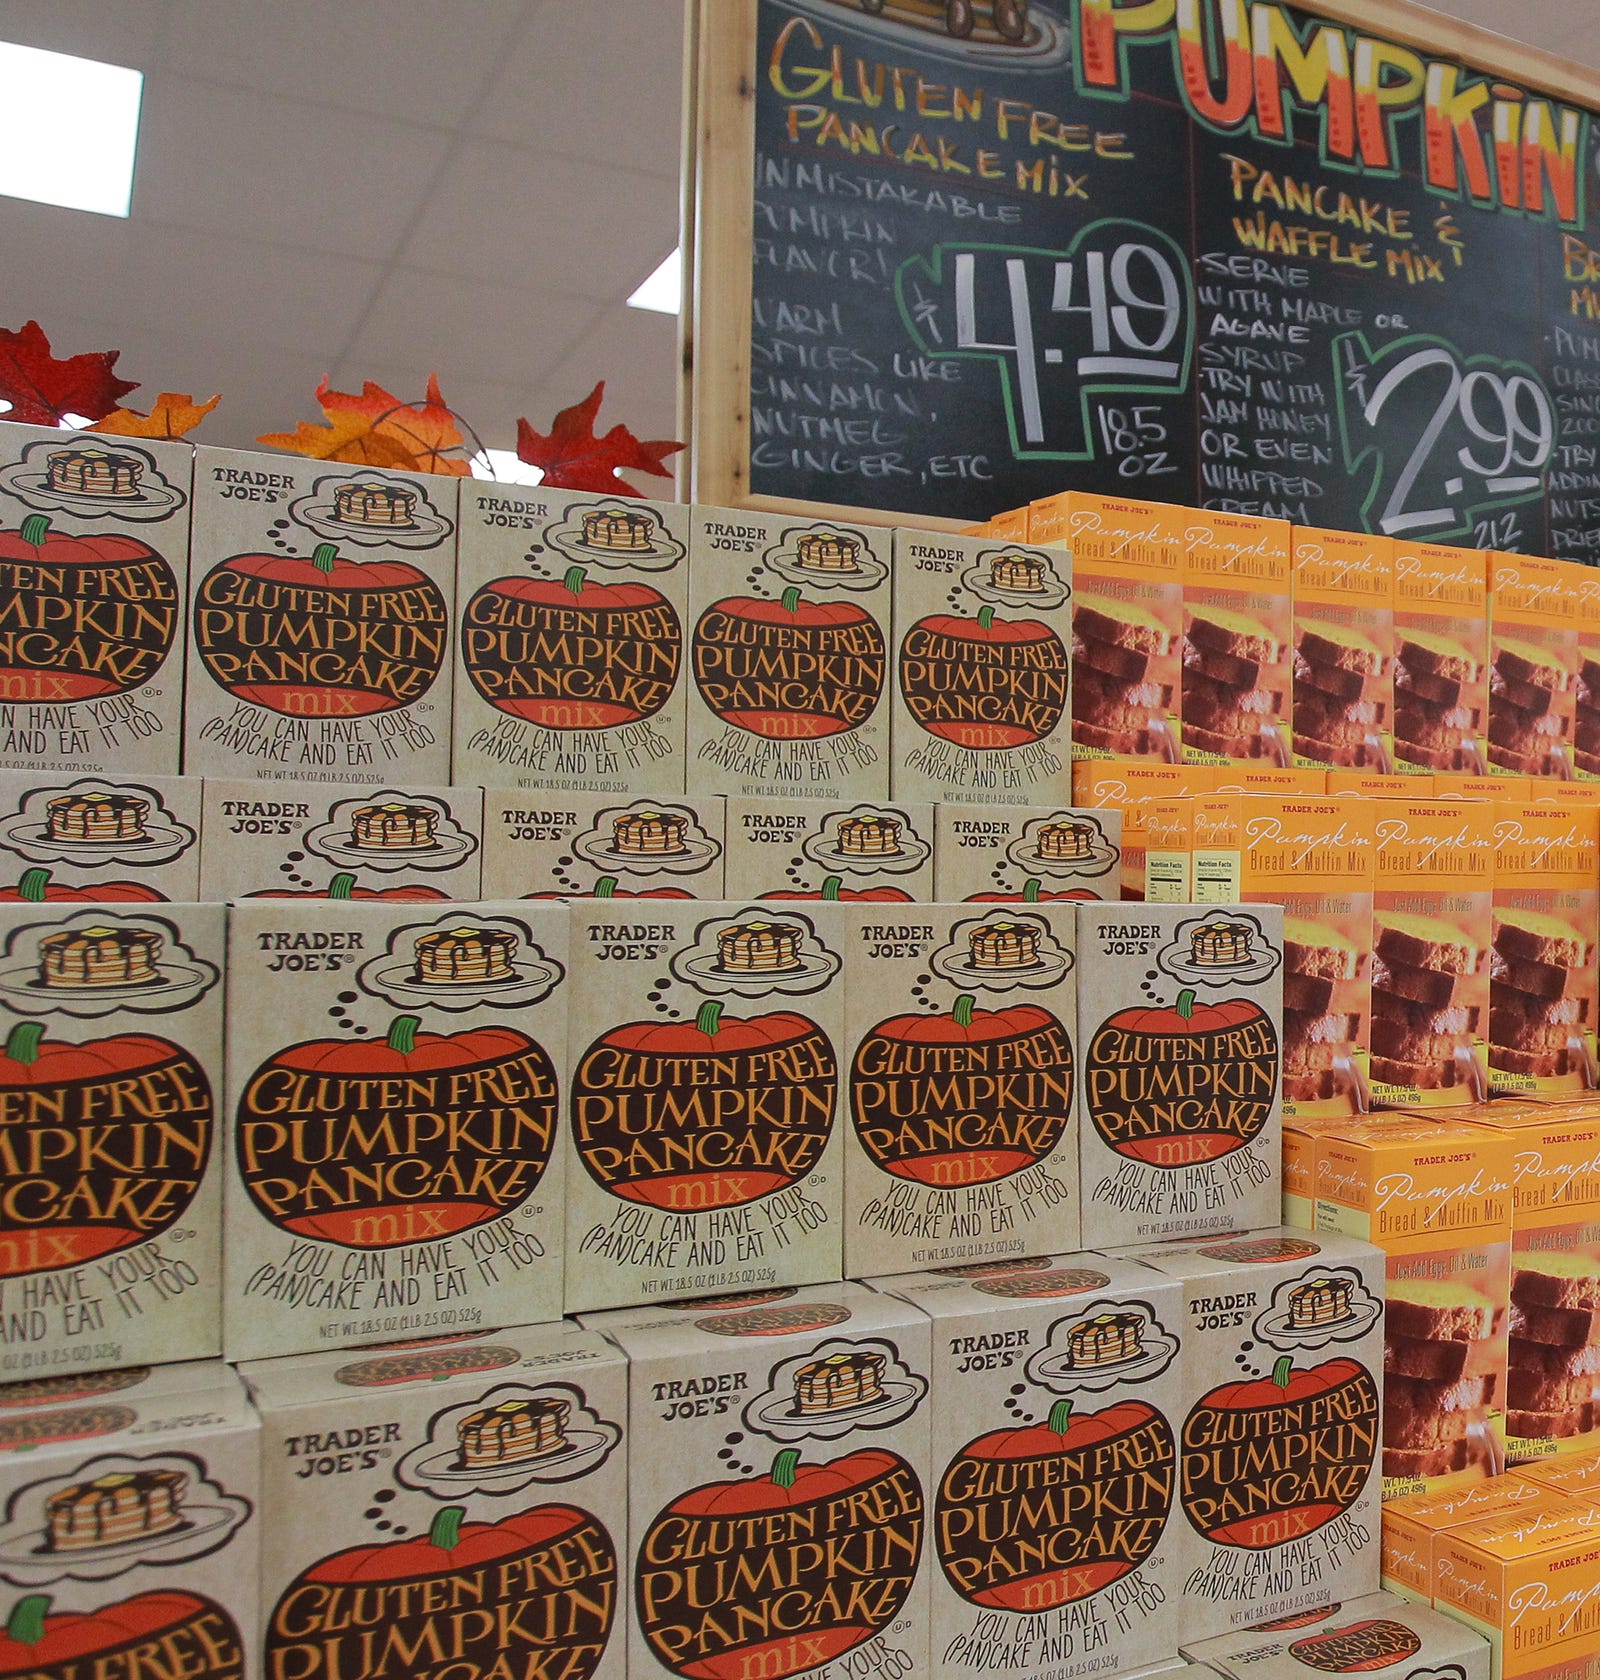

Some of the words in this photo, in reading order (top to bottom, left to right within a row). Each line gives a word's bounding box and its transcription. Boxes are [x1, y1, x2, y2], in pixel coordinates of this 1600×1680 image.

[769, 17, 983, 121] GLUTEN
[996, 100, 1134, 159] FREE
[786, 104, 1005, 178] PANCAKE
[1220, 153, 1414, 240] PANCAKE
[1235, 210, 1378, 268] WAFFLE
[1198, 286, 1272, 316] WITH
[1281, 298, 1362, 326] MAPLE
[1375, 313, 1408, 329] OR
[1210, 313, 1310, 344] AGAVE
[894, 353, 961, 382] LIKE
[1199, 342, 1304, 373] SYRUP
[1201, 392, 1247, 424] JAM
[1260, 380, 1324, 405] WITH
[1201, 429, 1248, 458] OR
[1254, 438, 1332, 464] EVEN
[212, 467, 295, 489] TRADER
[1202, 463, 1323, 497] WHIPPED
[703, 522, 767, 541] TRADER
[202, 571, 349, 615] GLUTEN
[361, 584, 445, 624] FREE
[200, 609, 444, 664] PUMPKIN
[698, 612, 812, 649] GLUTEN
[817, 623, 883, 656] FREE
[204, 652, 435, 699] PANCAKE
[696, 645, 884, 692] PUMPKIN
[284, 688, 359, 714] mix
[701, 681, 877, 722] PANCAKE
[760, 715, 818, 737] mix
[1282, 805, 1312, 814] TRADER
[1246, 816, 1371, 867] Pumpkin
[1250, 849, 1286, 871] Bread
[1305, 851, 1341, 871] Muffin
[1348, 852, 1367, 872] Mix
[257, 931, 364, 952] TRADER
[860, 925, 935, 941] TRADER
[856, 1037, 993, 1075] GLUTEN
[996, 1025, 1072, 1070] FREE
[247, 1068, 439, 1115] GLUTEN
[450, 1052, 556, 1105] FREE
[854, 1070, 1073, 1123] PUMPKIN
[242, 1105, 556, 1173] PUMPKIN
[861, 1112, 1064, 1160] PANCAKE
[931, 1150, 1000, 1184] mix
[1414, 1156, 1446, 1165] TRADER
[248, 1157, 544, 1215] PANCAKE
[1375, 1168, 1510, 1224] Pumpkin
[351, 1206, 448, 1243] mix
[1380, 1208, 1416, 1233] Bread
[1438, 1202, 1478, 1227] Muffin
[1484, 1199, 1505, 1221] Mix
[286, 1239, 334, 1278] YOU
[341, 1251, 384, 1281] CAN
[401, 1240, 456, 1273] HAVE
[463, 1217, 528, 1261] YOUR
[1412, 1261, 1426, 1277] Add
[1469, 1253, 1488, 1269] Water
[245, 1263, 362, 1313] (PAN)CAKE
[376, 1277, 421, 1307] AND
[435, 1270, 468, 1300] EAT
[480, 1257, 499, 1287] IT
[500, 1234, 545, 1275] TOO
[320, 1323, 338, 1338] NET
[384, 1317, 396, 1331] OZ
[949, 1329, 1030, 1355] TRADER
[943, 1453, 1085, 1502] GLUTEN
[1095, 1420, 1173, 1474] FREE
[940, 1465, 1173, 1555] PUMPKIN
[946, 1517, 1165, 1592] PANCAKE
[1548, 1556, 1581, 1572] TRADER
[1022, 1567, 1096, 1609] mix
[1514, 1617, 1551, 1650] Bread
